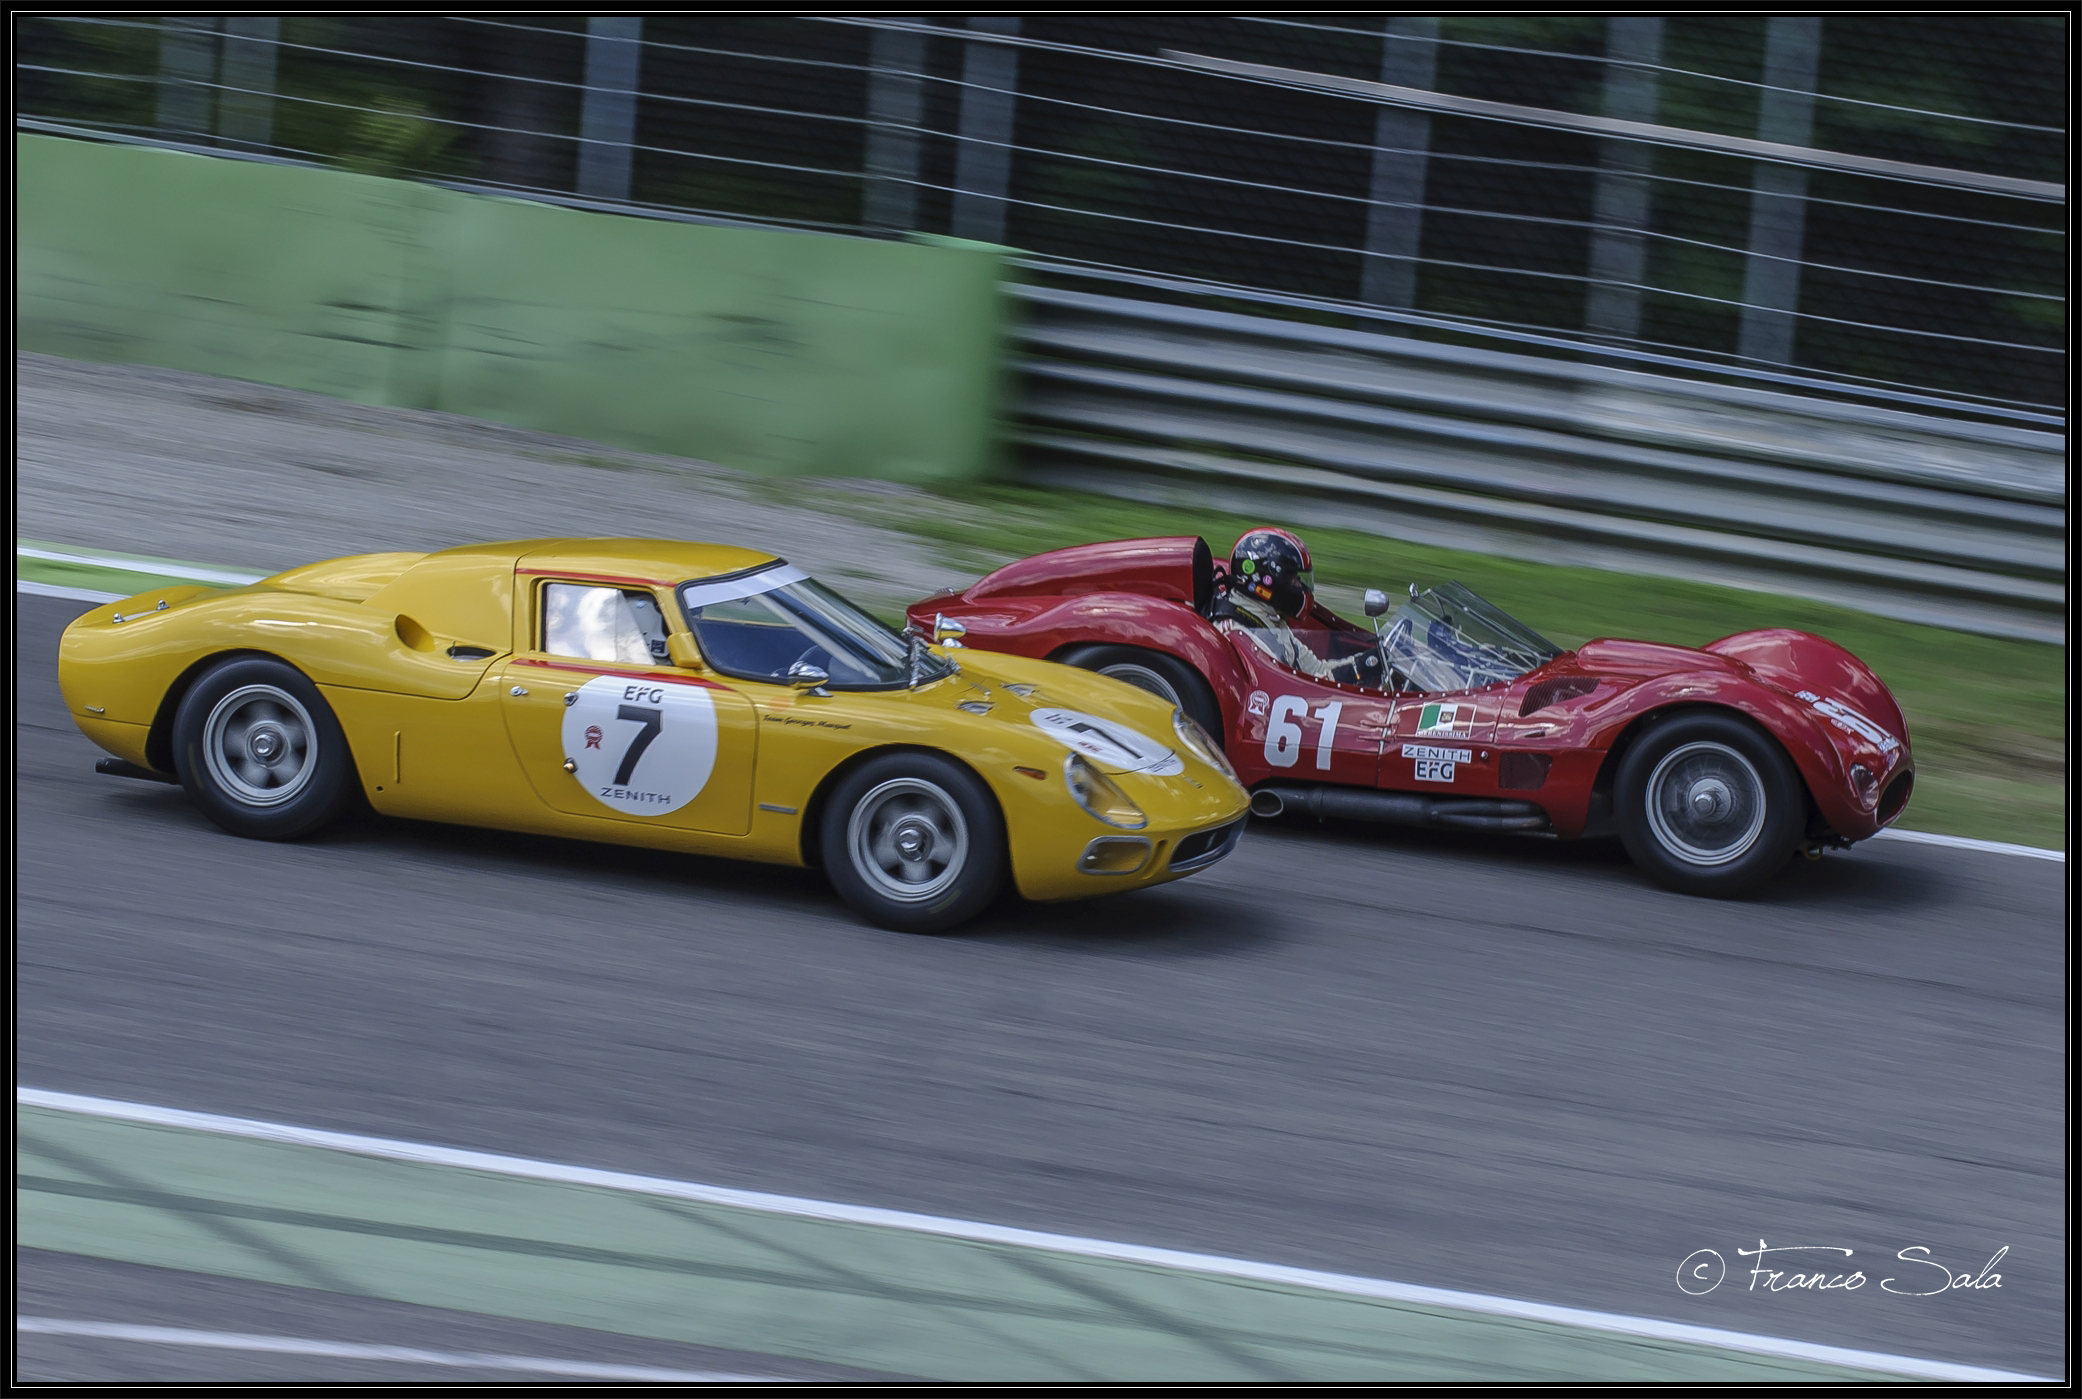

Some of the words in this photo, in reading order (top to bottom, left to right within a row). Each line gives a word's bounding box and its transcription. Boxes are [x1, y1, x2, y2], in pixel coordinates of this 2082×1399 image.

[624, 685, 664, 704] EFG
[1066, 722, 1143, 759] 7
[1264, 694, 1343, 771] 61
[612, 704, 663, 786] 7
[1404, 746, 1471, 762] ZENITH
[1416, 760, 1453, 780] EFG
[600, 787, 671, 804] ZENITH
